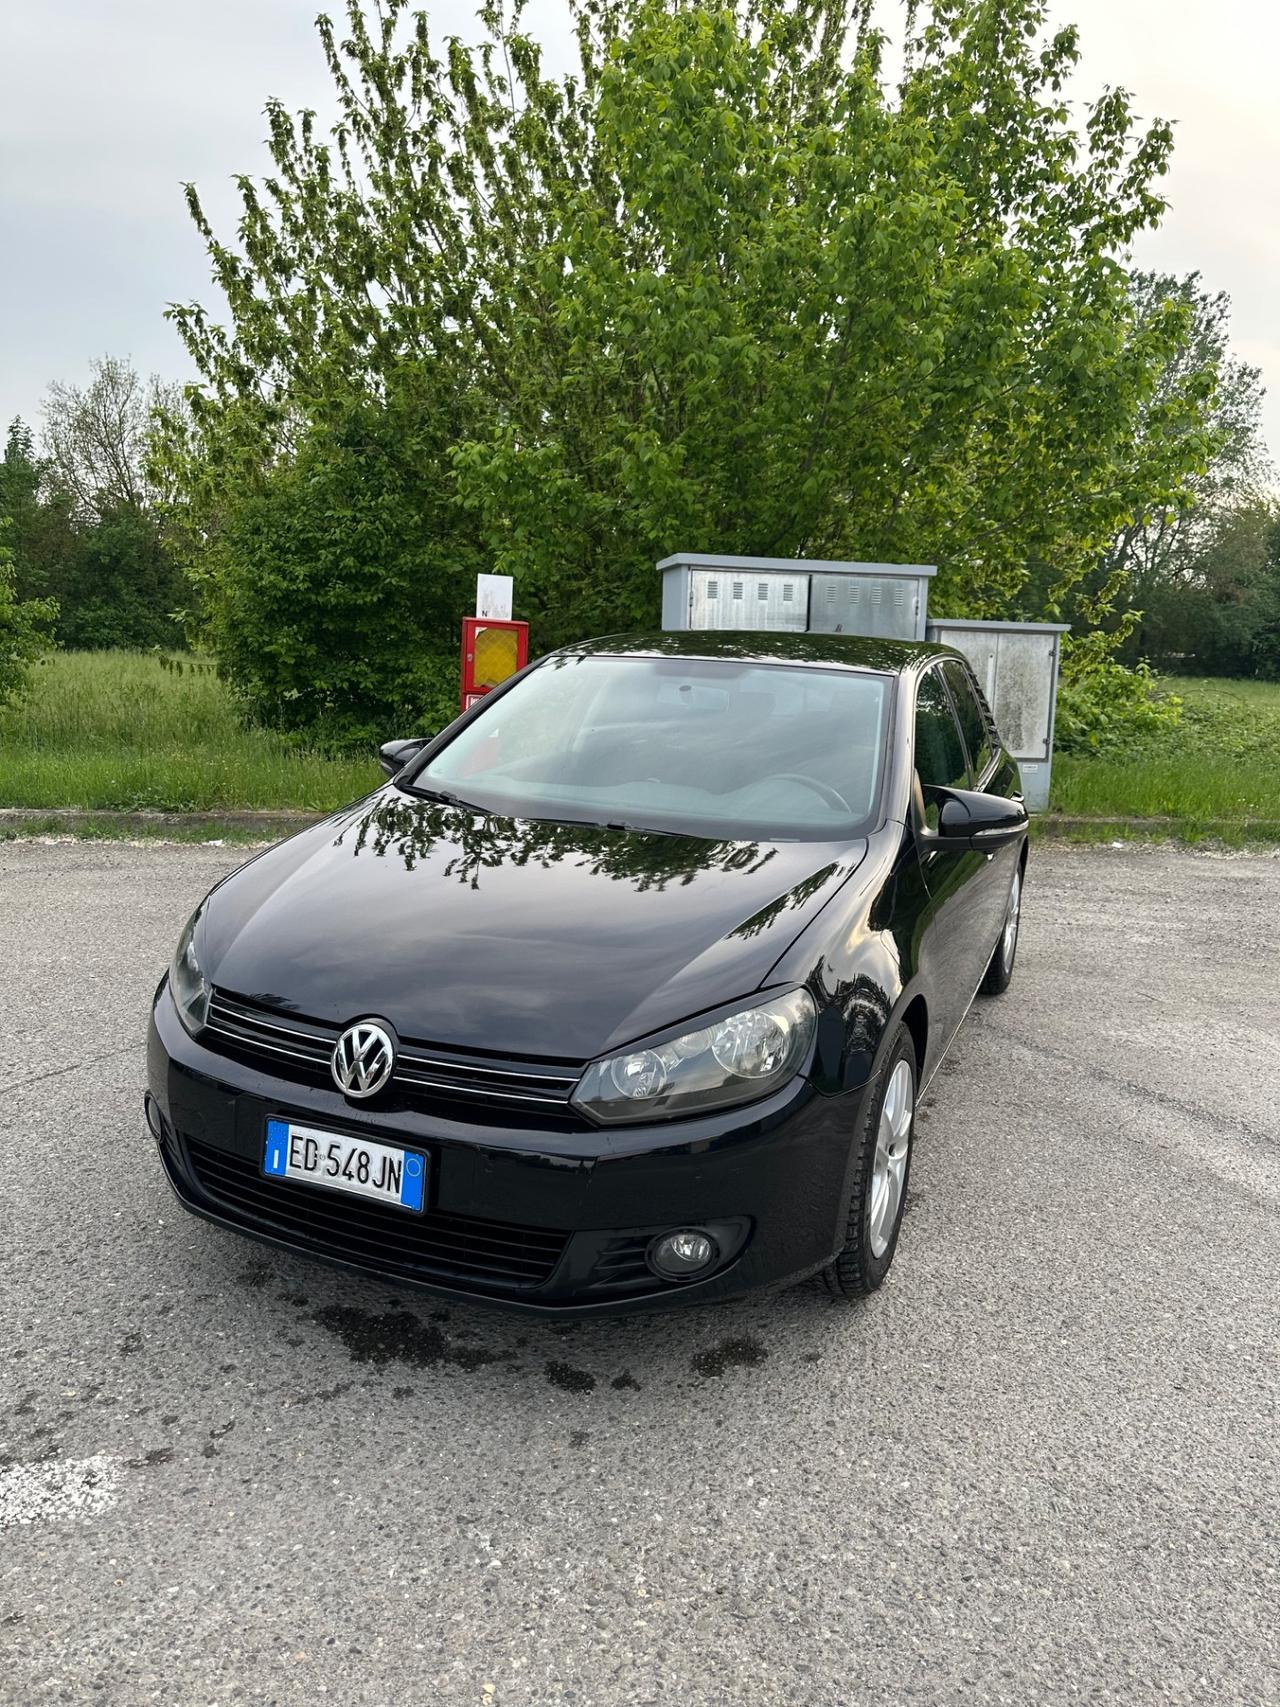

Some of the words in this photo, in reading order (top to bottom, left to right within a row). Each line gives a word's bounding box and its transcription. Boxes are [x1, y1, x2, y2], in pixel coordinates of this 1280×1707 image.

[336, 1024, 388, 1093] VW
[289, 1135, 318, 1171] ED
[326, 1144, 403, 1194] 548JN
